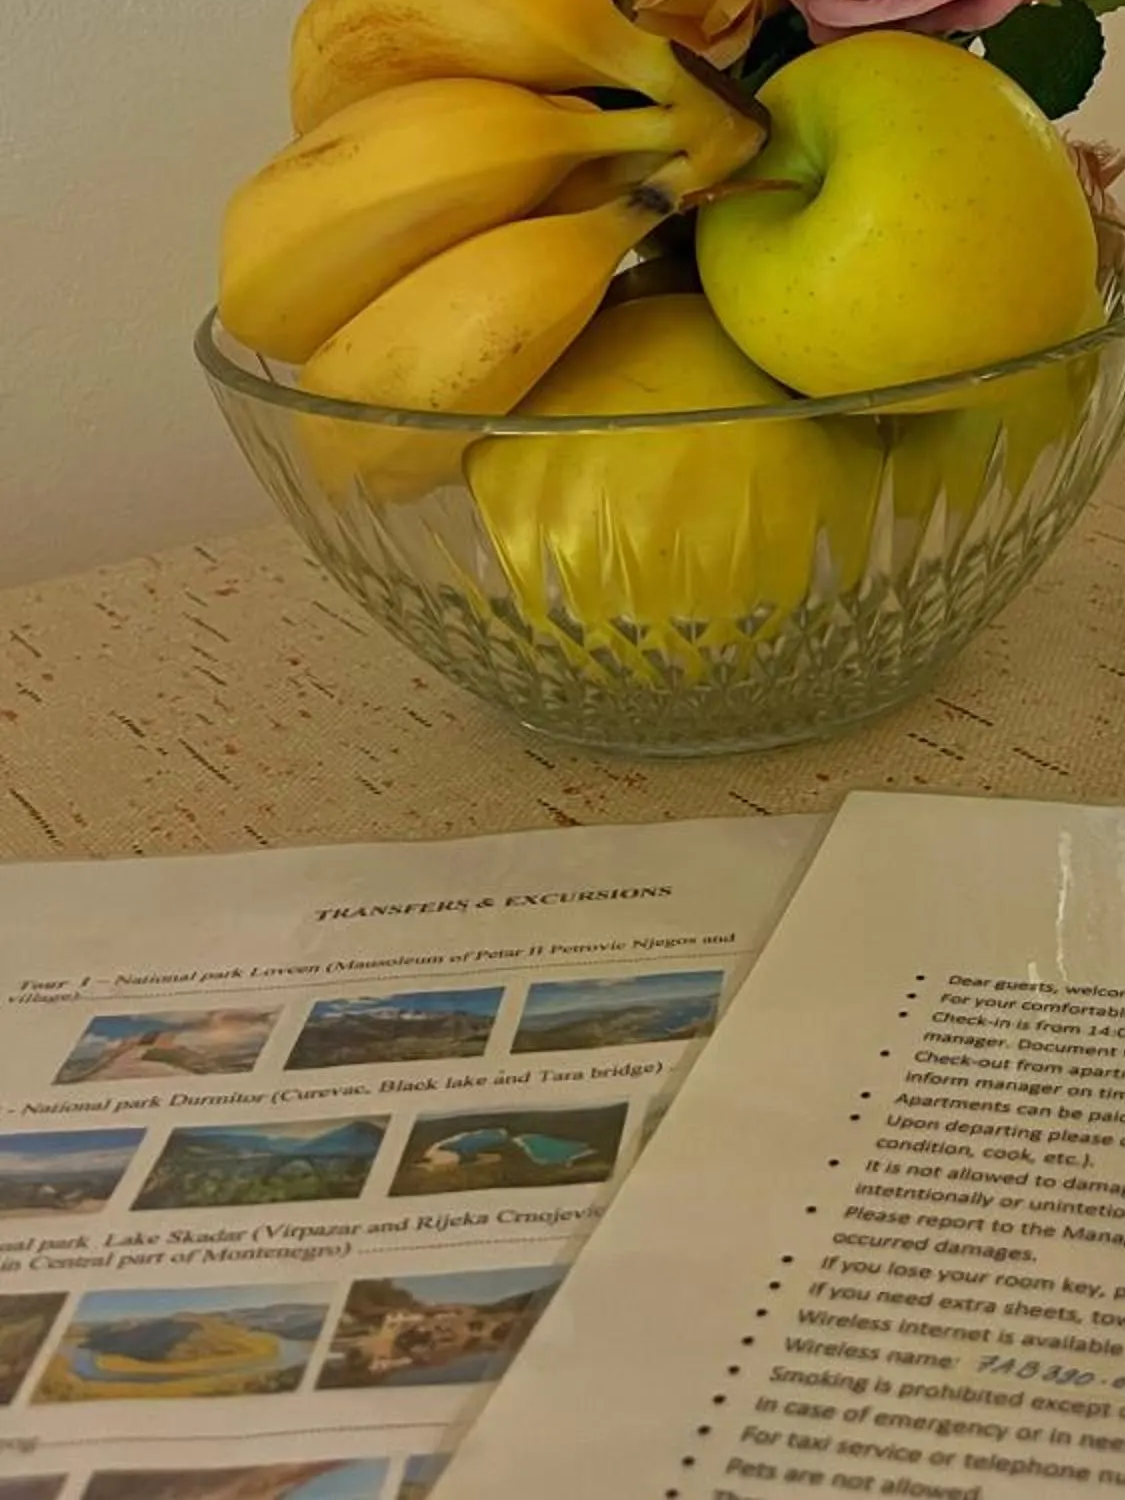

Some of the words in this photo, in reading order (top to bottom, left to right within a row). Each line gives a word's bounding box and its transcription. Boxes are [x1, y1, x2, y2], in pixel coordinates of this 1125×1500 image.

[315, 898, 469, 922] TRANSFERS
[475, 897, 494, 909] &
[504, 886, 672, 907] EXCURSIONS
[949, 974, 990, 989] Dear
[932, 1011, 1010, 1030] Check-in
[1018, 1039, 1116, 1058] Document
[914, 1051, 1010, 1070] Check-out
[906, 1071, 969, 1088] inform
[975, 1080, 1062, 1098] manager
[895, 1093, 1011, 1113] Apartments
[886, 1114, 939, 1131] Upon
[945, 1117, 1042, 1142] departing
[1048, 1128, 1113, 1146] please
[947, 1166, 1029, 1186] allowed
[843, 1206, 910, 1226] Please
[916, 1213, 985, 1233] report
[832, 1230, 929, 1252] occurred
[888, 1262, 932, 1279] lose
[994, 1272, 1055, 1292] room
[938, 1295, 997, 1314] extra
[798, 1308, 892, 1333] Wireless
[898, 1319, 991, 1343] internet
[1021, 1331, 1124, 1357] available
[784, 1336, 879, 1361] Wireless
[769, 1365, 870, 1393] Smoking
[898, 1381, 1025, 1408] prohibited
[1030, 1394, 1111, 1417] except
